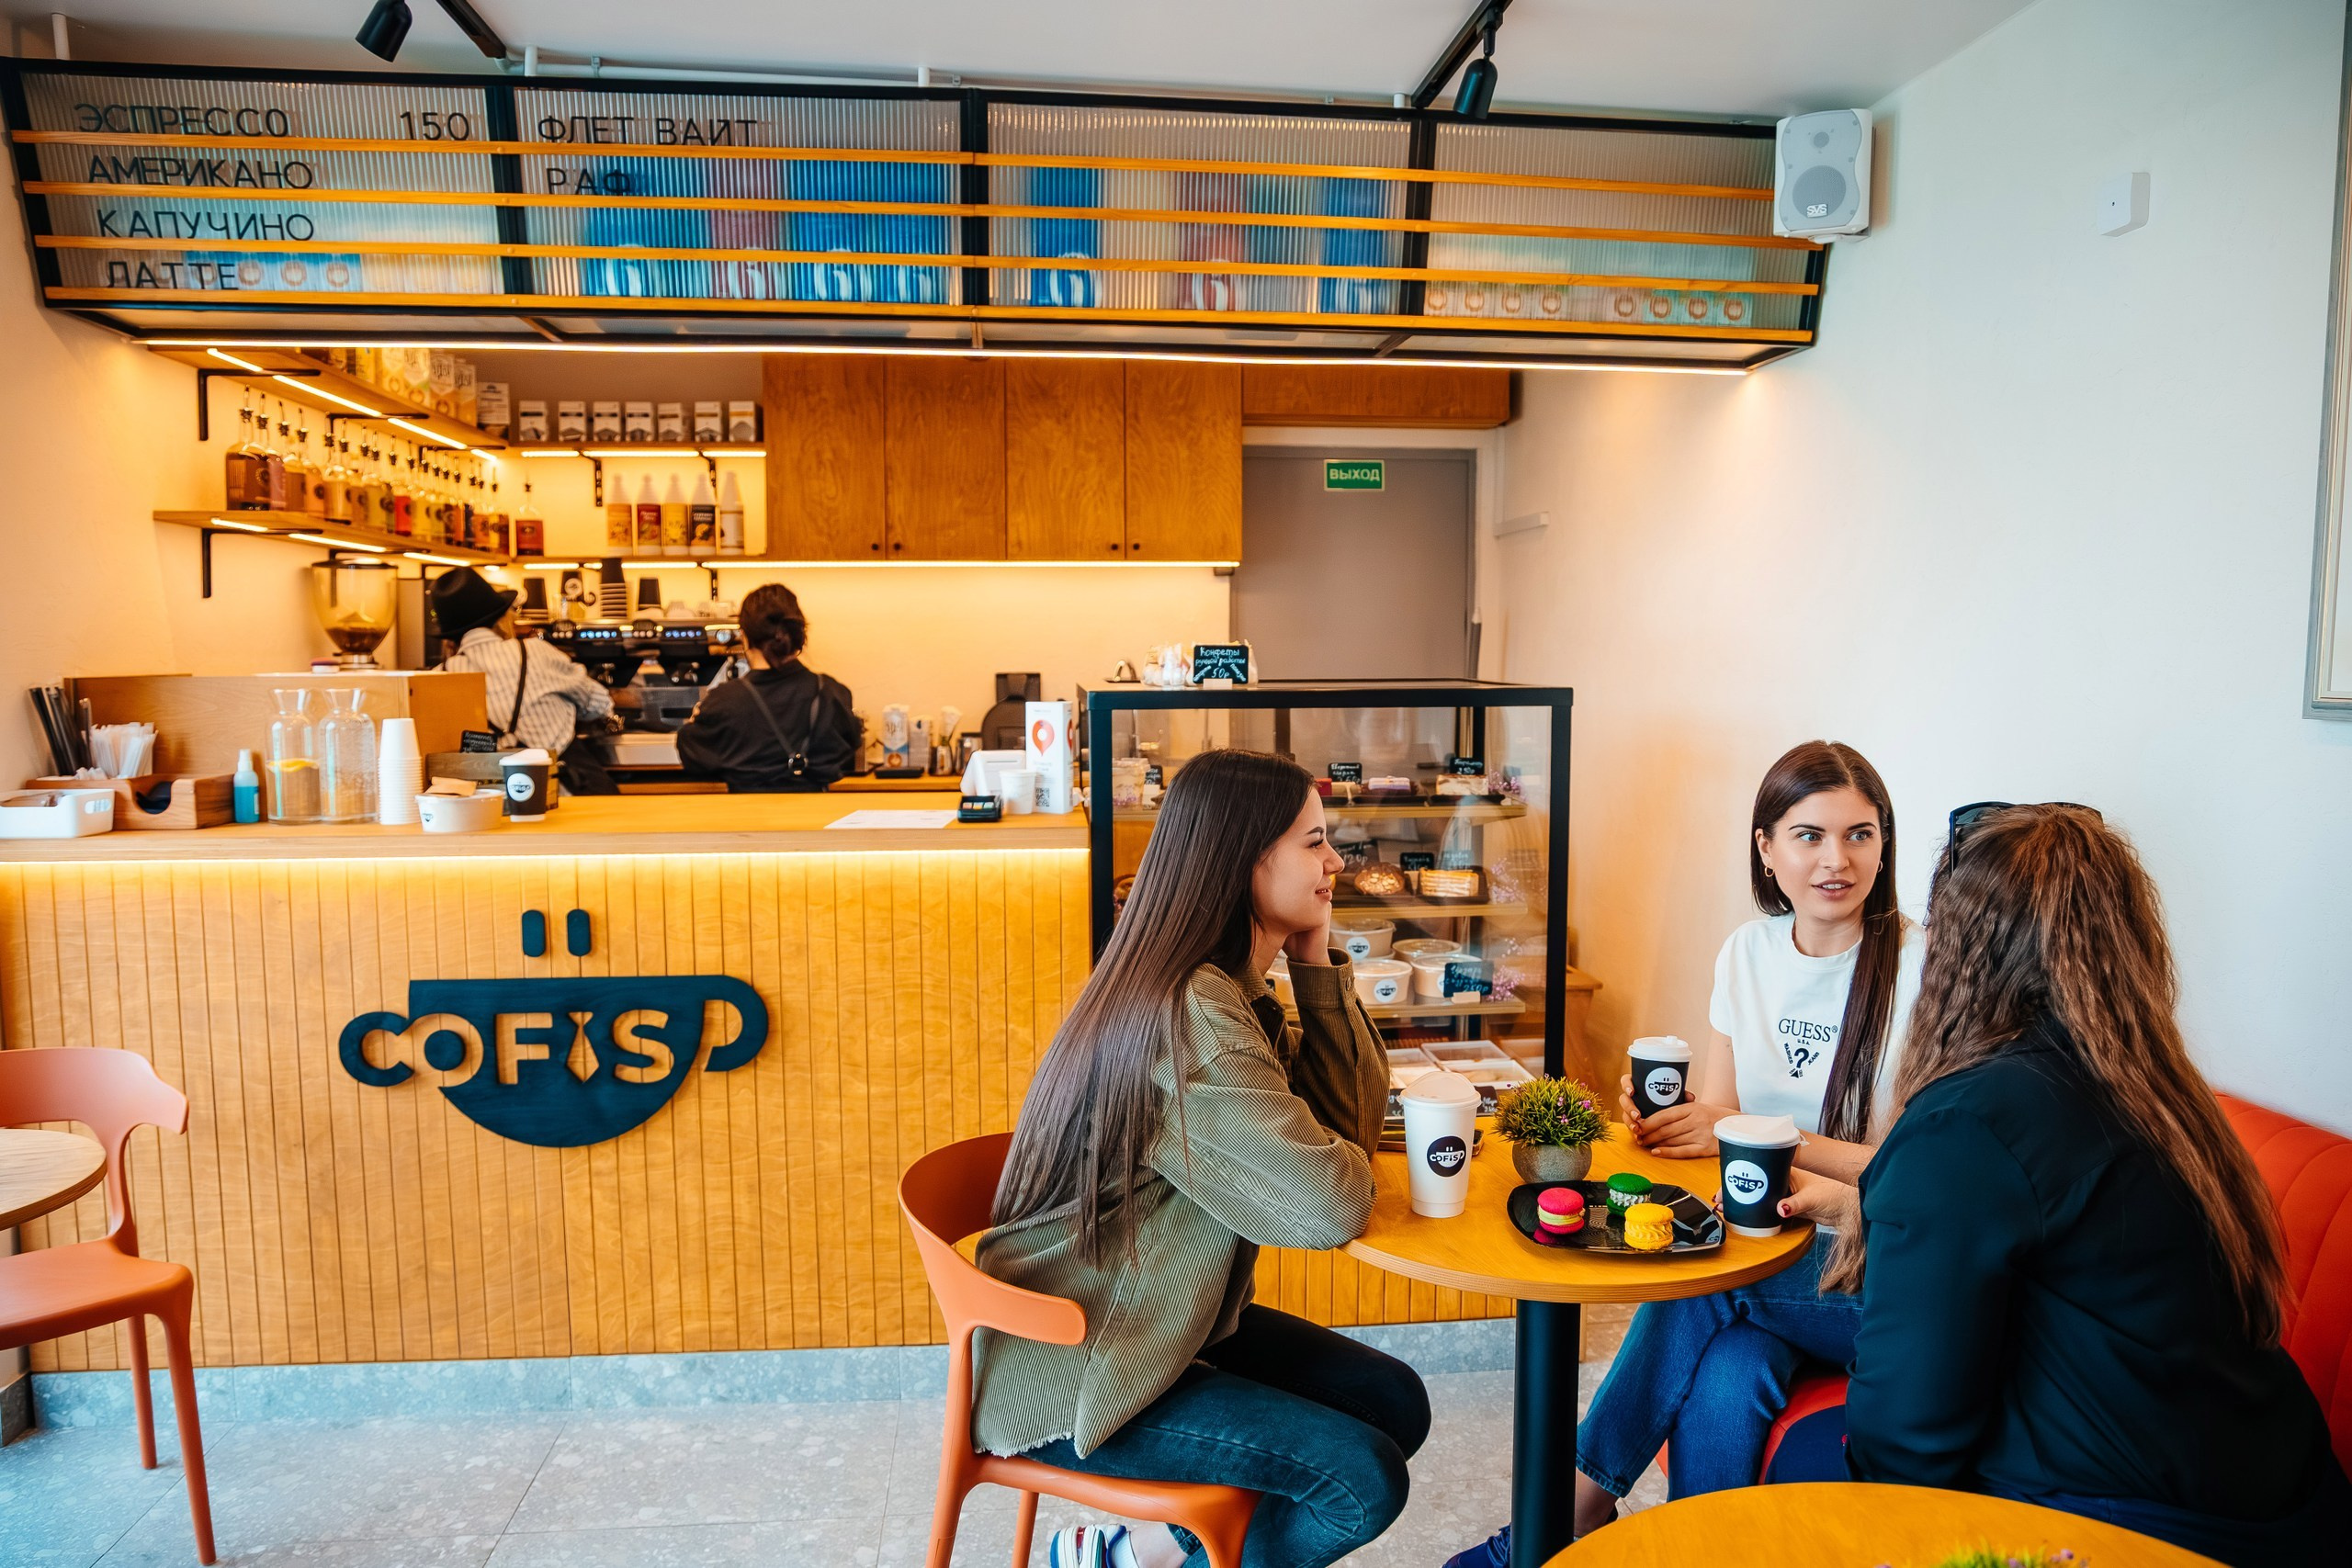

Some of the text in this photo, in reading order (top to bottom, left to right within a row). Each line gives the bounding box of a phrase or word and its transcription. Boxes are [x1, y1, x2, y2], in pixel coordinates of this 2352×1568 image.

[74, 103, 469, 141] ЭСПРЕССО 150
[537, 116, 634, 144] ФЛЕТ
[89, 154, 313, 189] АМЕРИКАНО
[546, 167, 631, 197] РАФ
[1806, 203, 1827, 216] SVS
[96, 209, 314, 242] КАПУЧИНО
[107, 261, 239, 290] ЛАТТЕ
[1329, 468, 1380, 481] ВЫХОД
